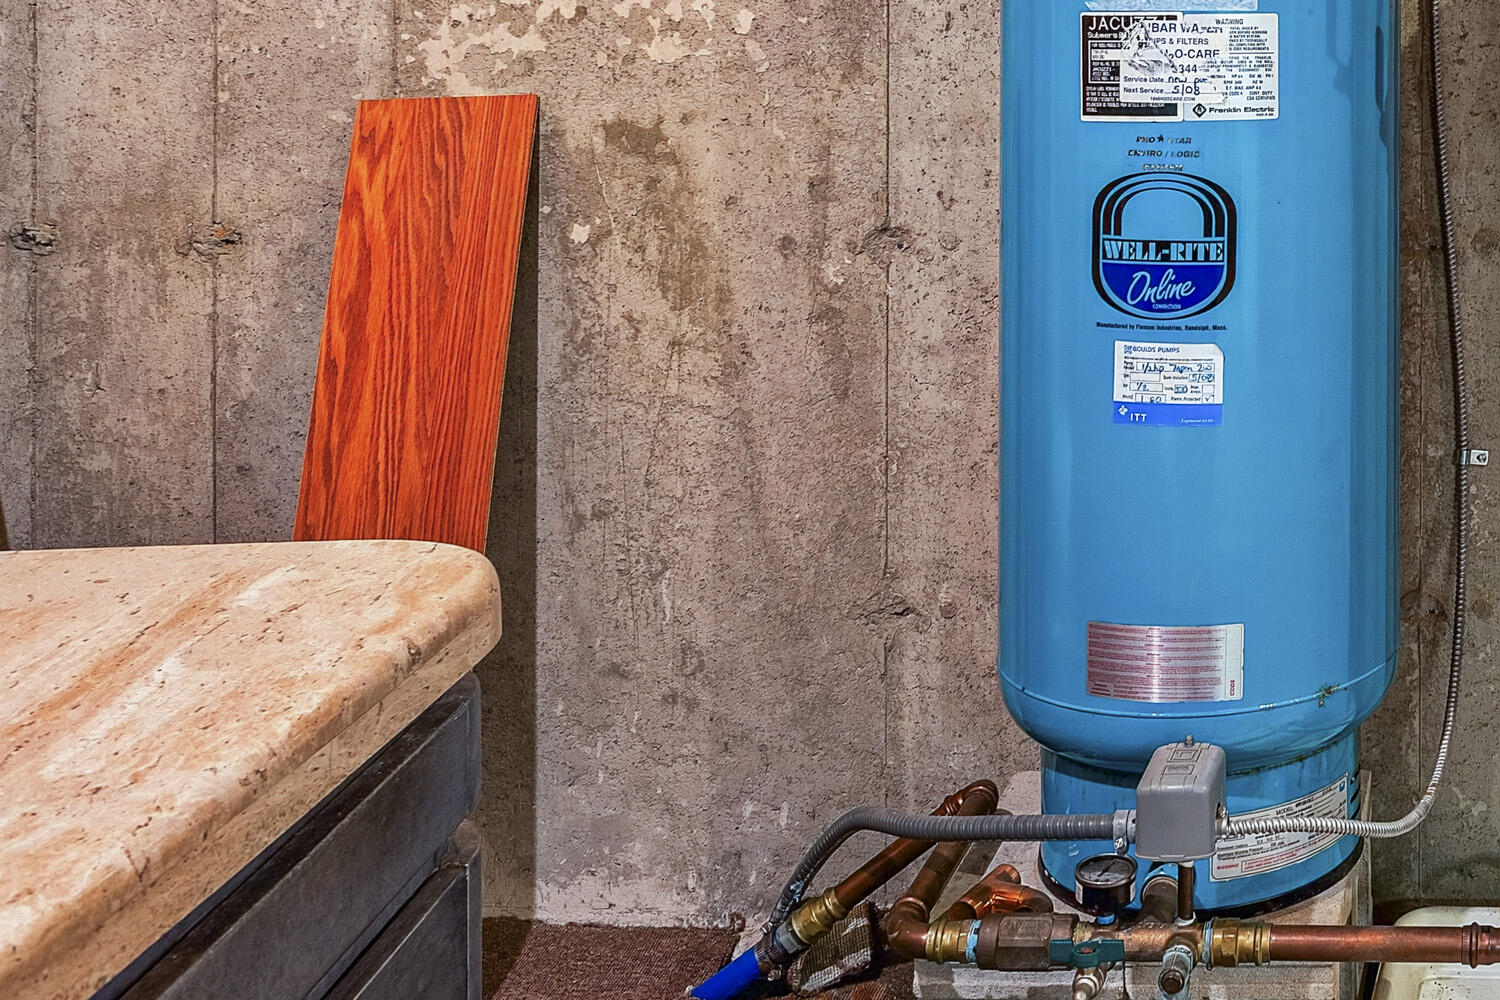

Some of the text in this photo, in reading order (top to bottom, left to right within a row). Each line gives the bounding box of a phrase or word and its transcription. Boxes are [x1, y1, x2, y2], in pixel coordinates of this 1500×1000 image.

[1149, 23, 1176, 32] BAR
[1103, 240, 1223, 261] WELL-RITE
[1127, 268, 1195, 305] Online
[1130, 413, 1147, 421] ITT
